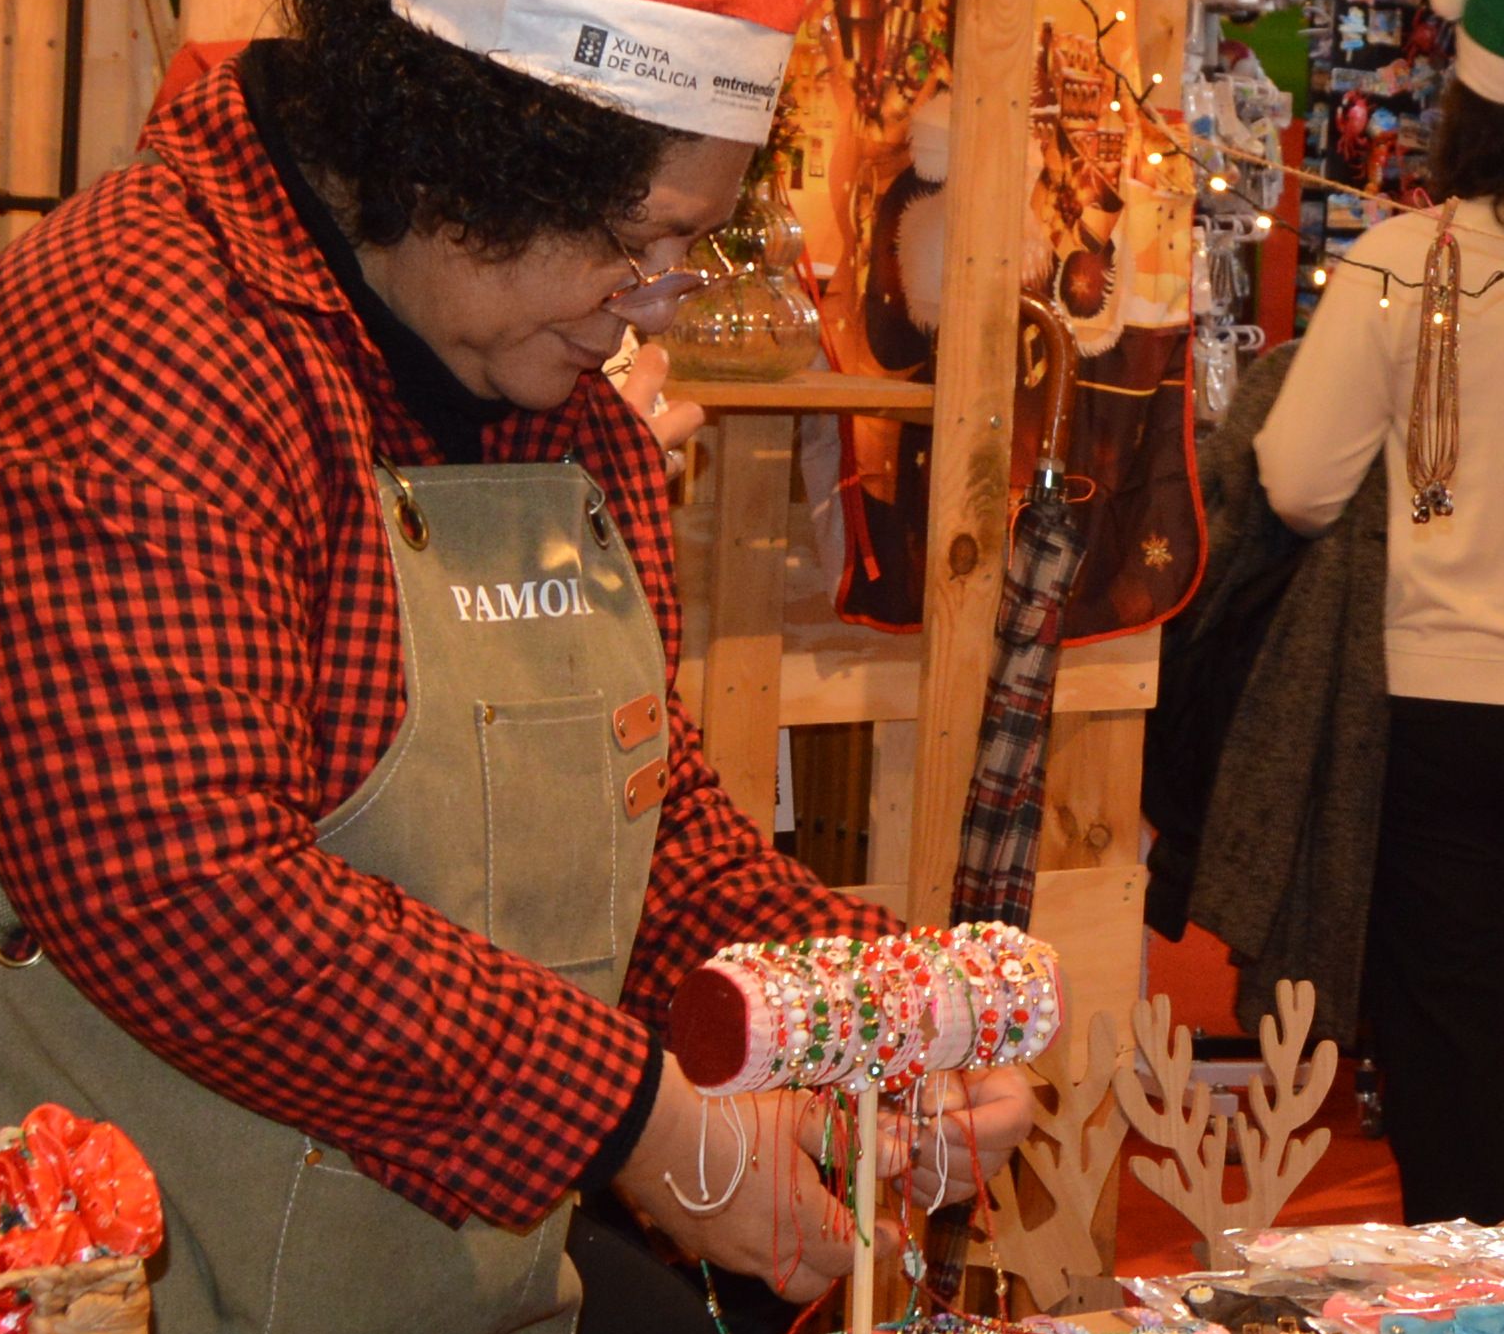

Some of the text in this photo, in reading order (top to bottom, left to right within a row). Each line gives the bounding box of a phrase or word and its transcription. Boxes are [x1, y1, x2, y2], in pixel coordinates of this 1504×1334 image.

[612, 36, 671, 66] XUNTA
[607, 54, 697, 91] DE GALICIA
